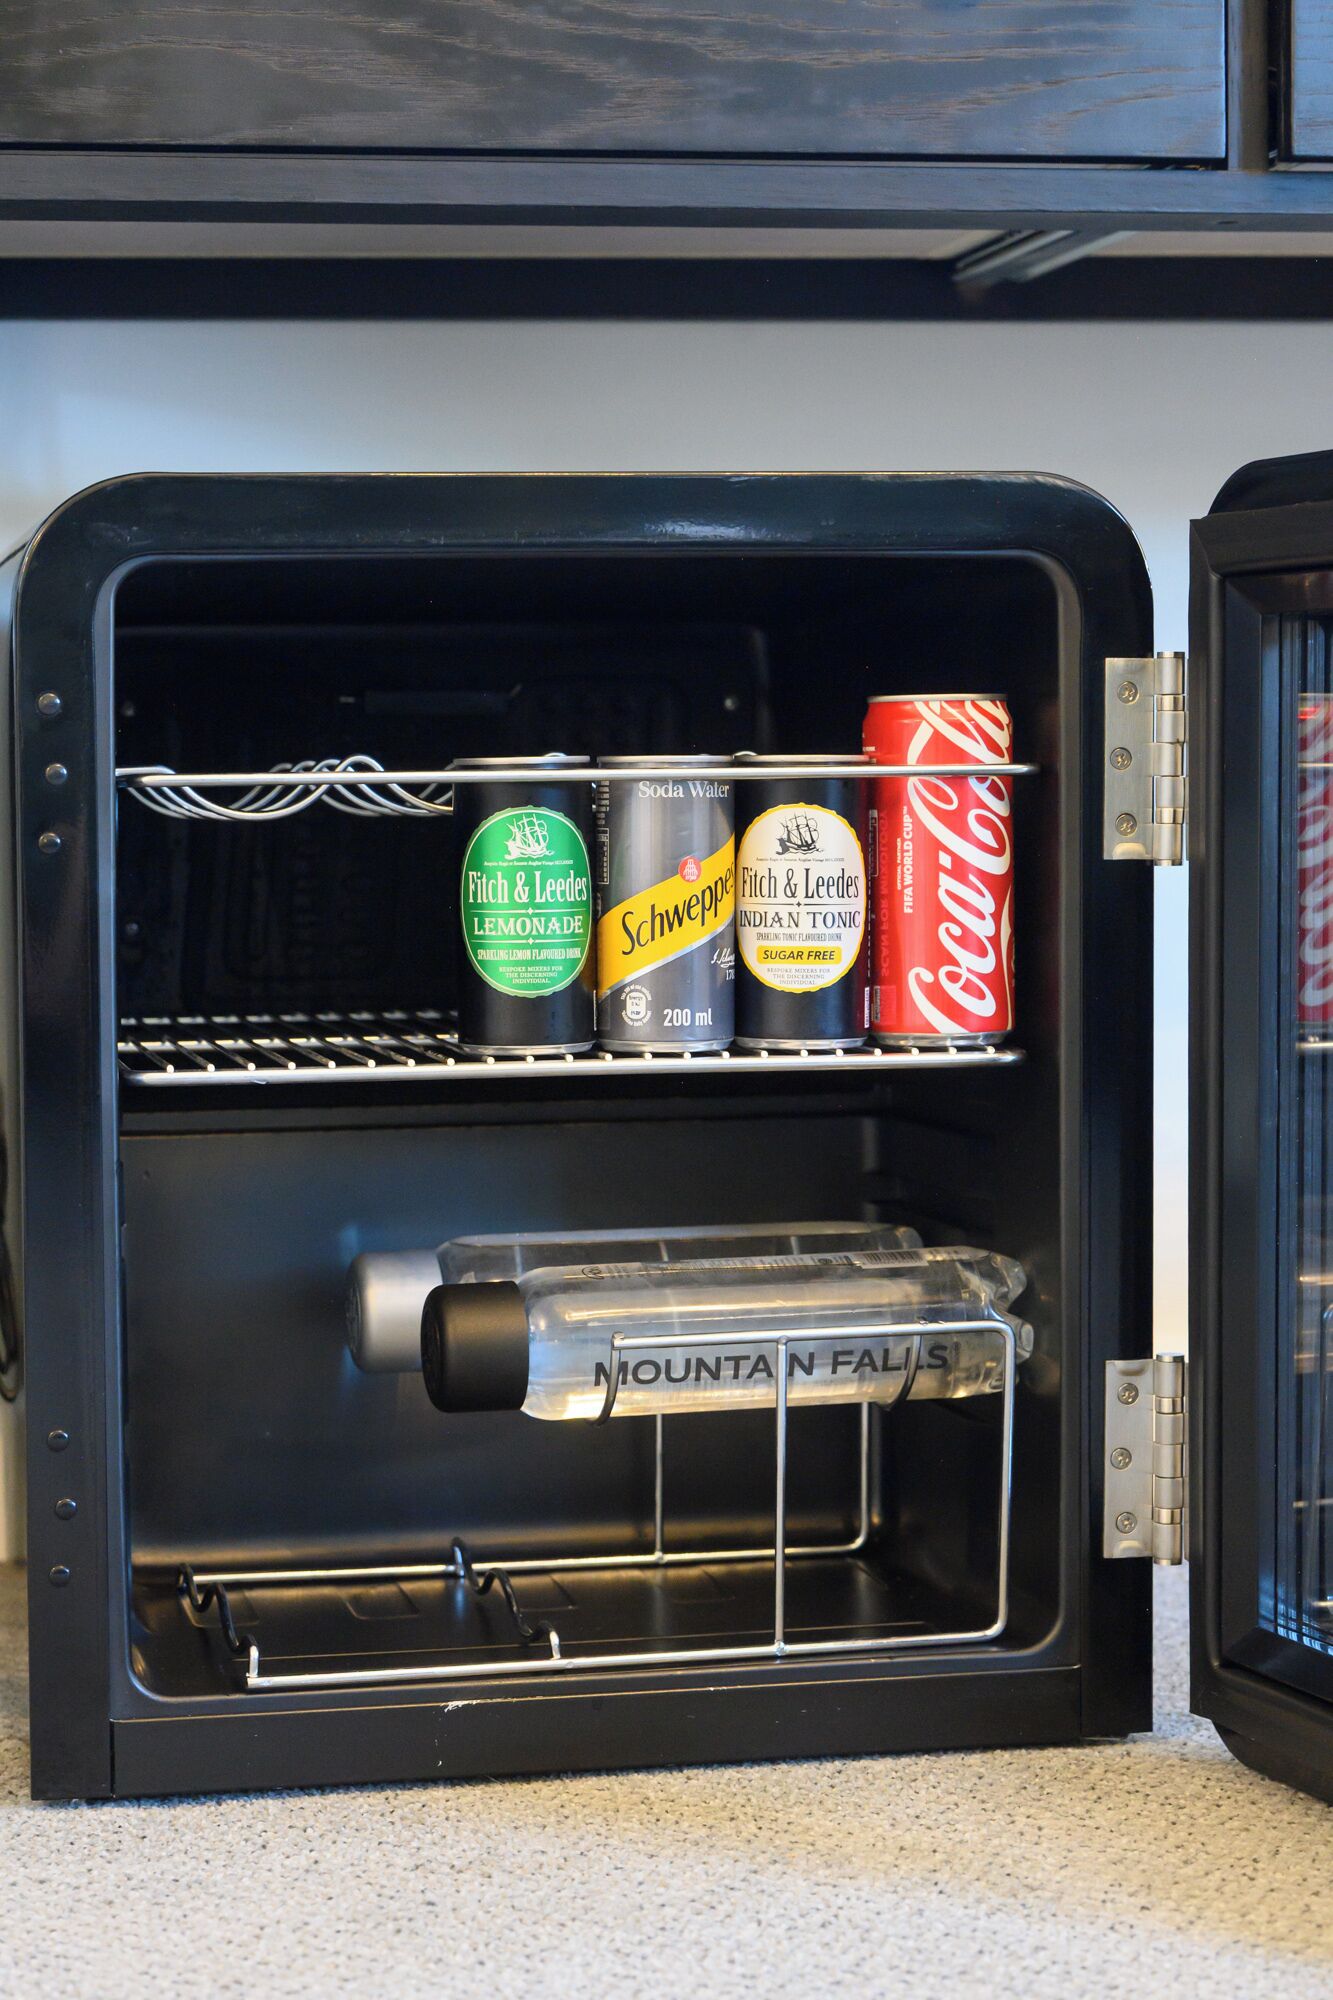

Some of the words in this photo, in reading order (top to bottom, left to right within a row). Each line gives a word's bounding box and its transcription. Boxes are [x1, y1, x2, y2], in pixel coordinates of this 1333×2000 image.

[638, 780, 684, 798] Soda
[688, 780, 730, 798] Water
[904, 840, 913, 886] WORLD
[468, 870, 509, 904] Fitch
[514, 871, 530, 902] &
[534, 870, 587, 903] Leedes
[741, 867, 778, 898] Fitch
[784, 868, 798, 898] &
[804, 868, 859, 898] Leedes
[904, 887, 913, 914] FIFA
[474, 916, 584, 936] LEMONADE
[740, 910, 800, 928] INDIAN
[806, 910, 860, 928] TONIC
[756, 932, 781, 940] SPARKLING
[782, 932, 798, 941] TONIC
[798, 933, 826, 941] FLAVOURED
[828, 932, 842, 941] DRINK
[478, 949, 508, 960] SPARKLING
[510, 949, 532, 960] LEMON
[532, 948, 565, 960] FLAVOURED
[566, 947, 581, 958] DRINK
[763, 950, 803, 960] SUGAR
[807, 950, 835, 960] FREE
[664, 1009, 691, 1027] 200
[695, 1008, 712, 1026] ml
[594, 1350, 815, 1386] MOUNTAN
